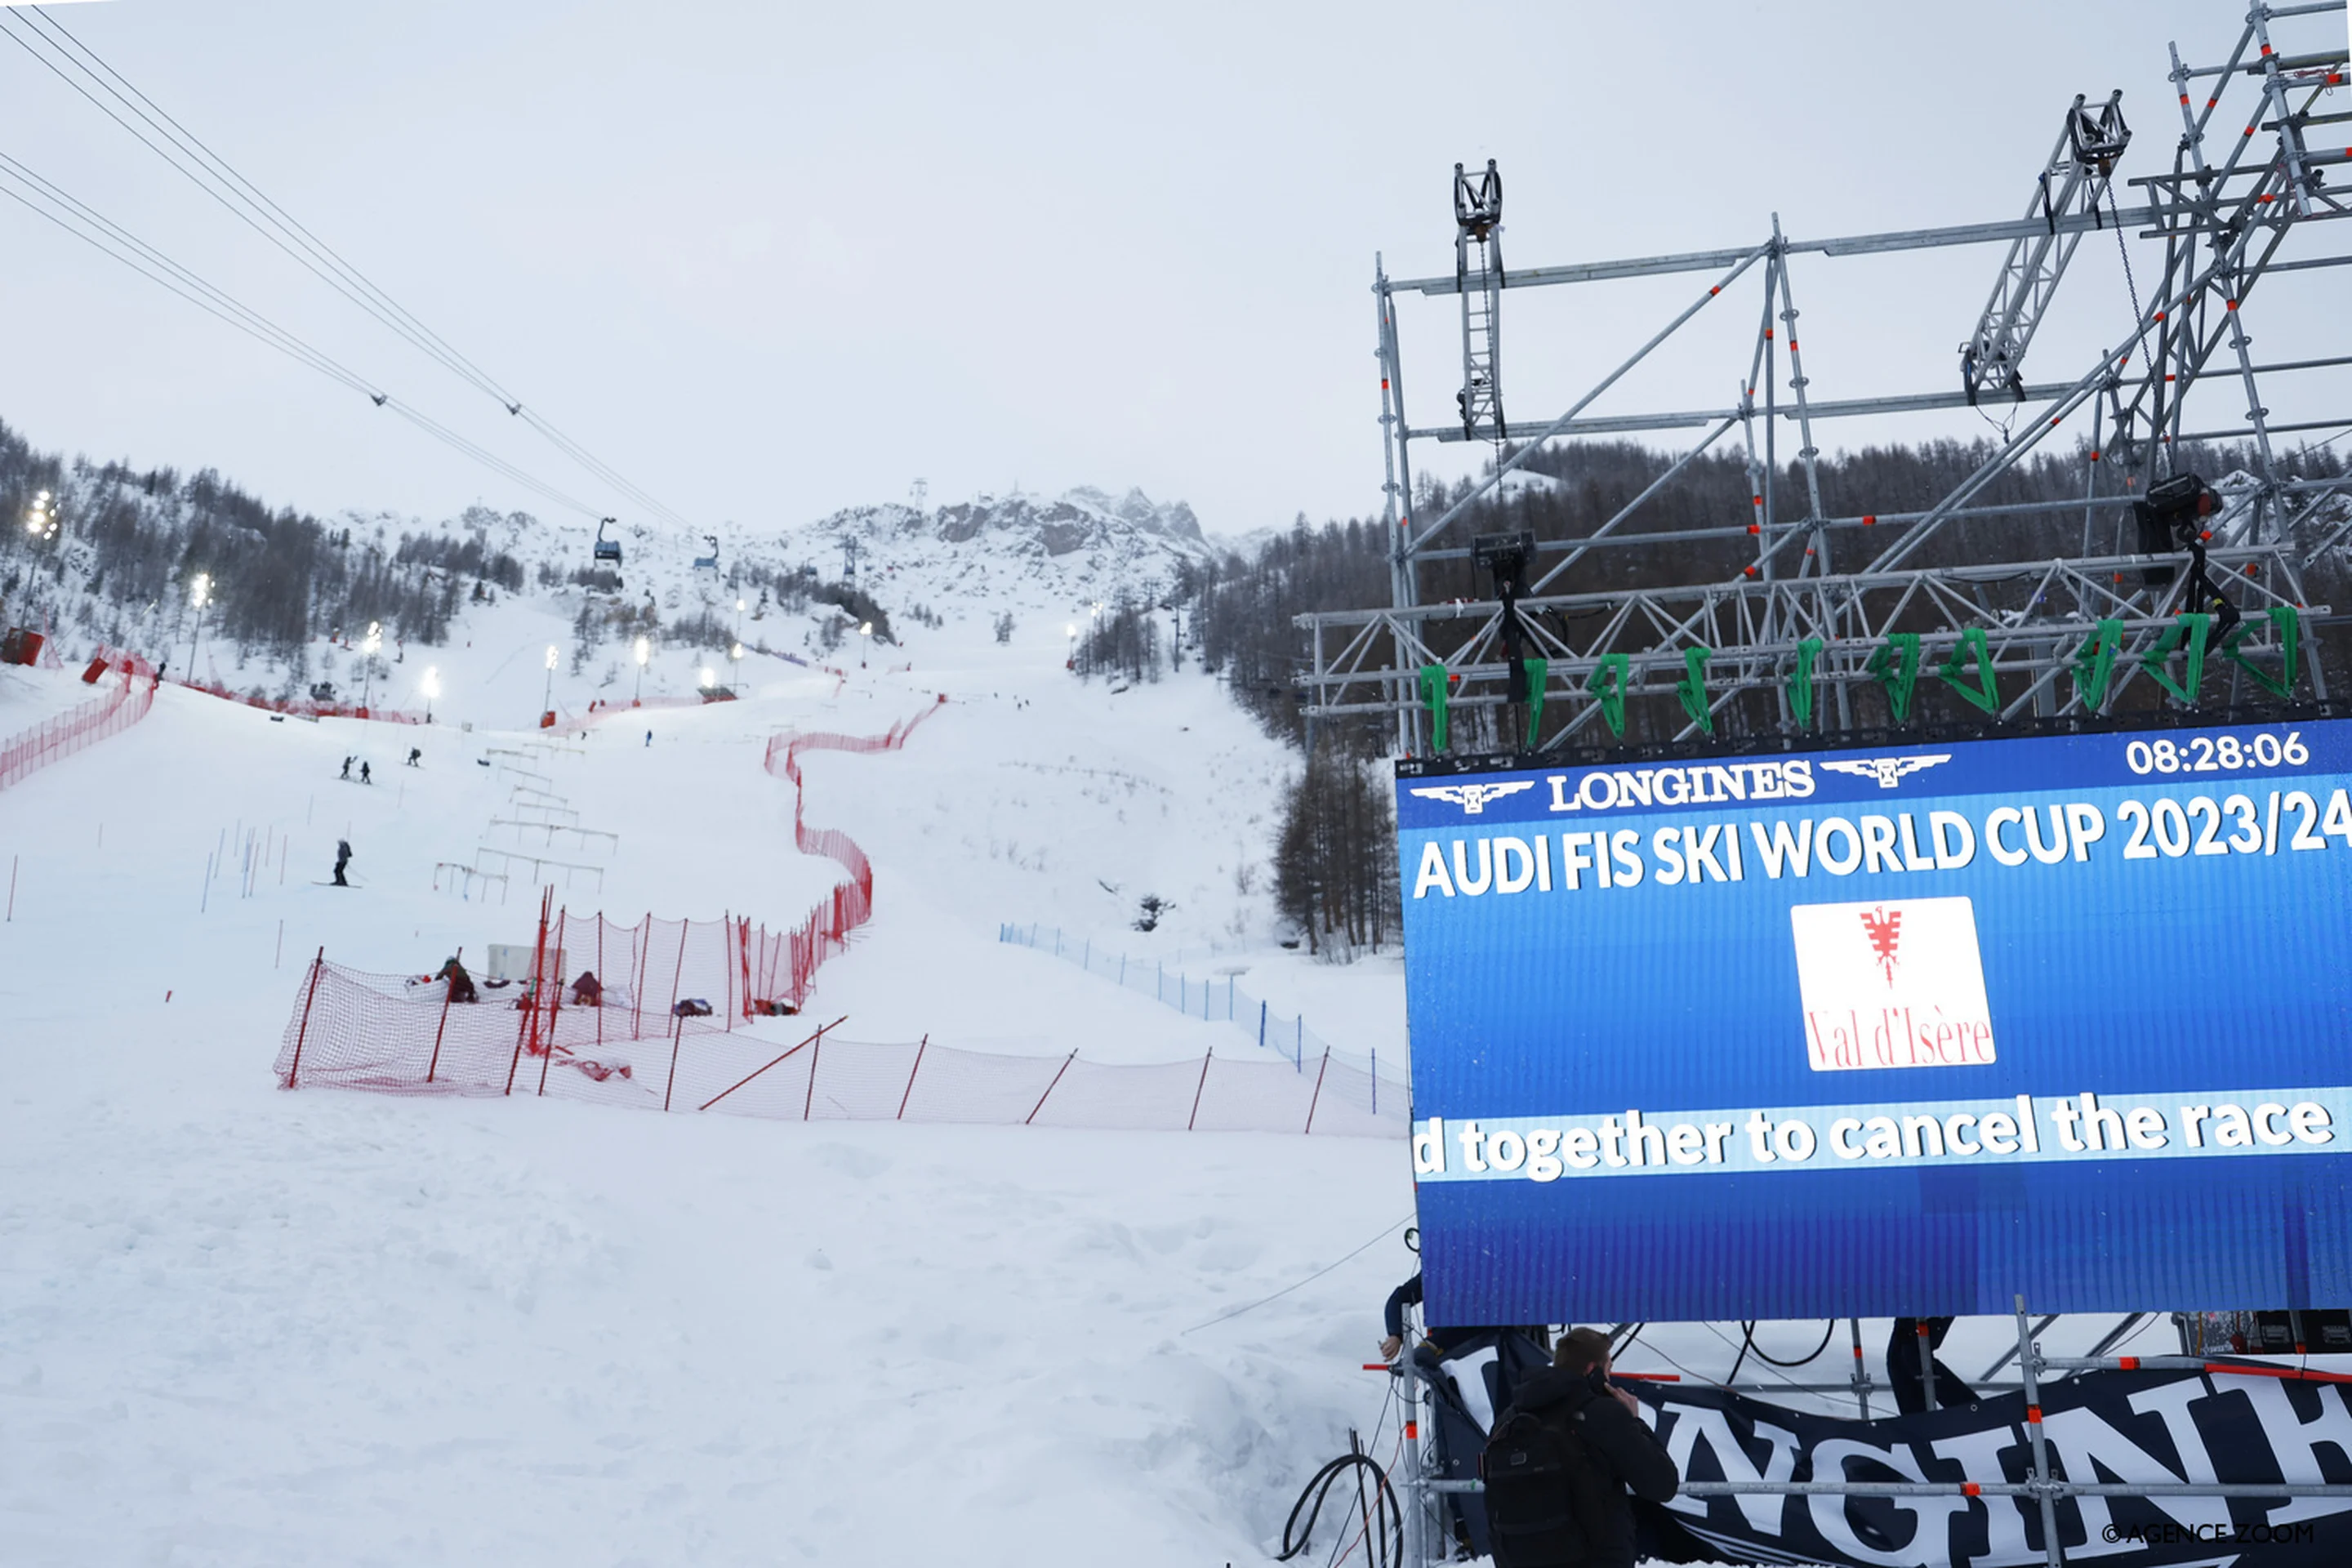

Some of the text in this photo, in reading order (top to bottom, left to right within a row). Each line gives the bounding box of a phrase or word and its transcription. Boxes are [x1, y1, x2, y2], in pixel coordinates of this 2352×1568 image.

[2126, 732, 2310, 774] 08:28:06
[1547, 760, 1815, 812] LONGINES
[1414, 789, 2352, 899] AUDI FIS SKI WORLD CUP 2023/24
[1809, 1005, 1990, 1067] Val d'Isère
[1458, 1110, 1733, 1183] together
[1744, 1110, 1817, 1163] to
[1829, 1095, 2039, 1160] cancel
[2051, 1093, 2168, 1152] the
[2180, 1102, 2334, 1147] race
